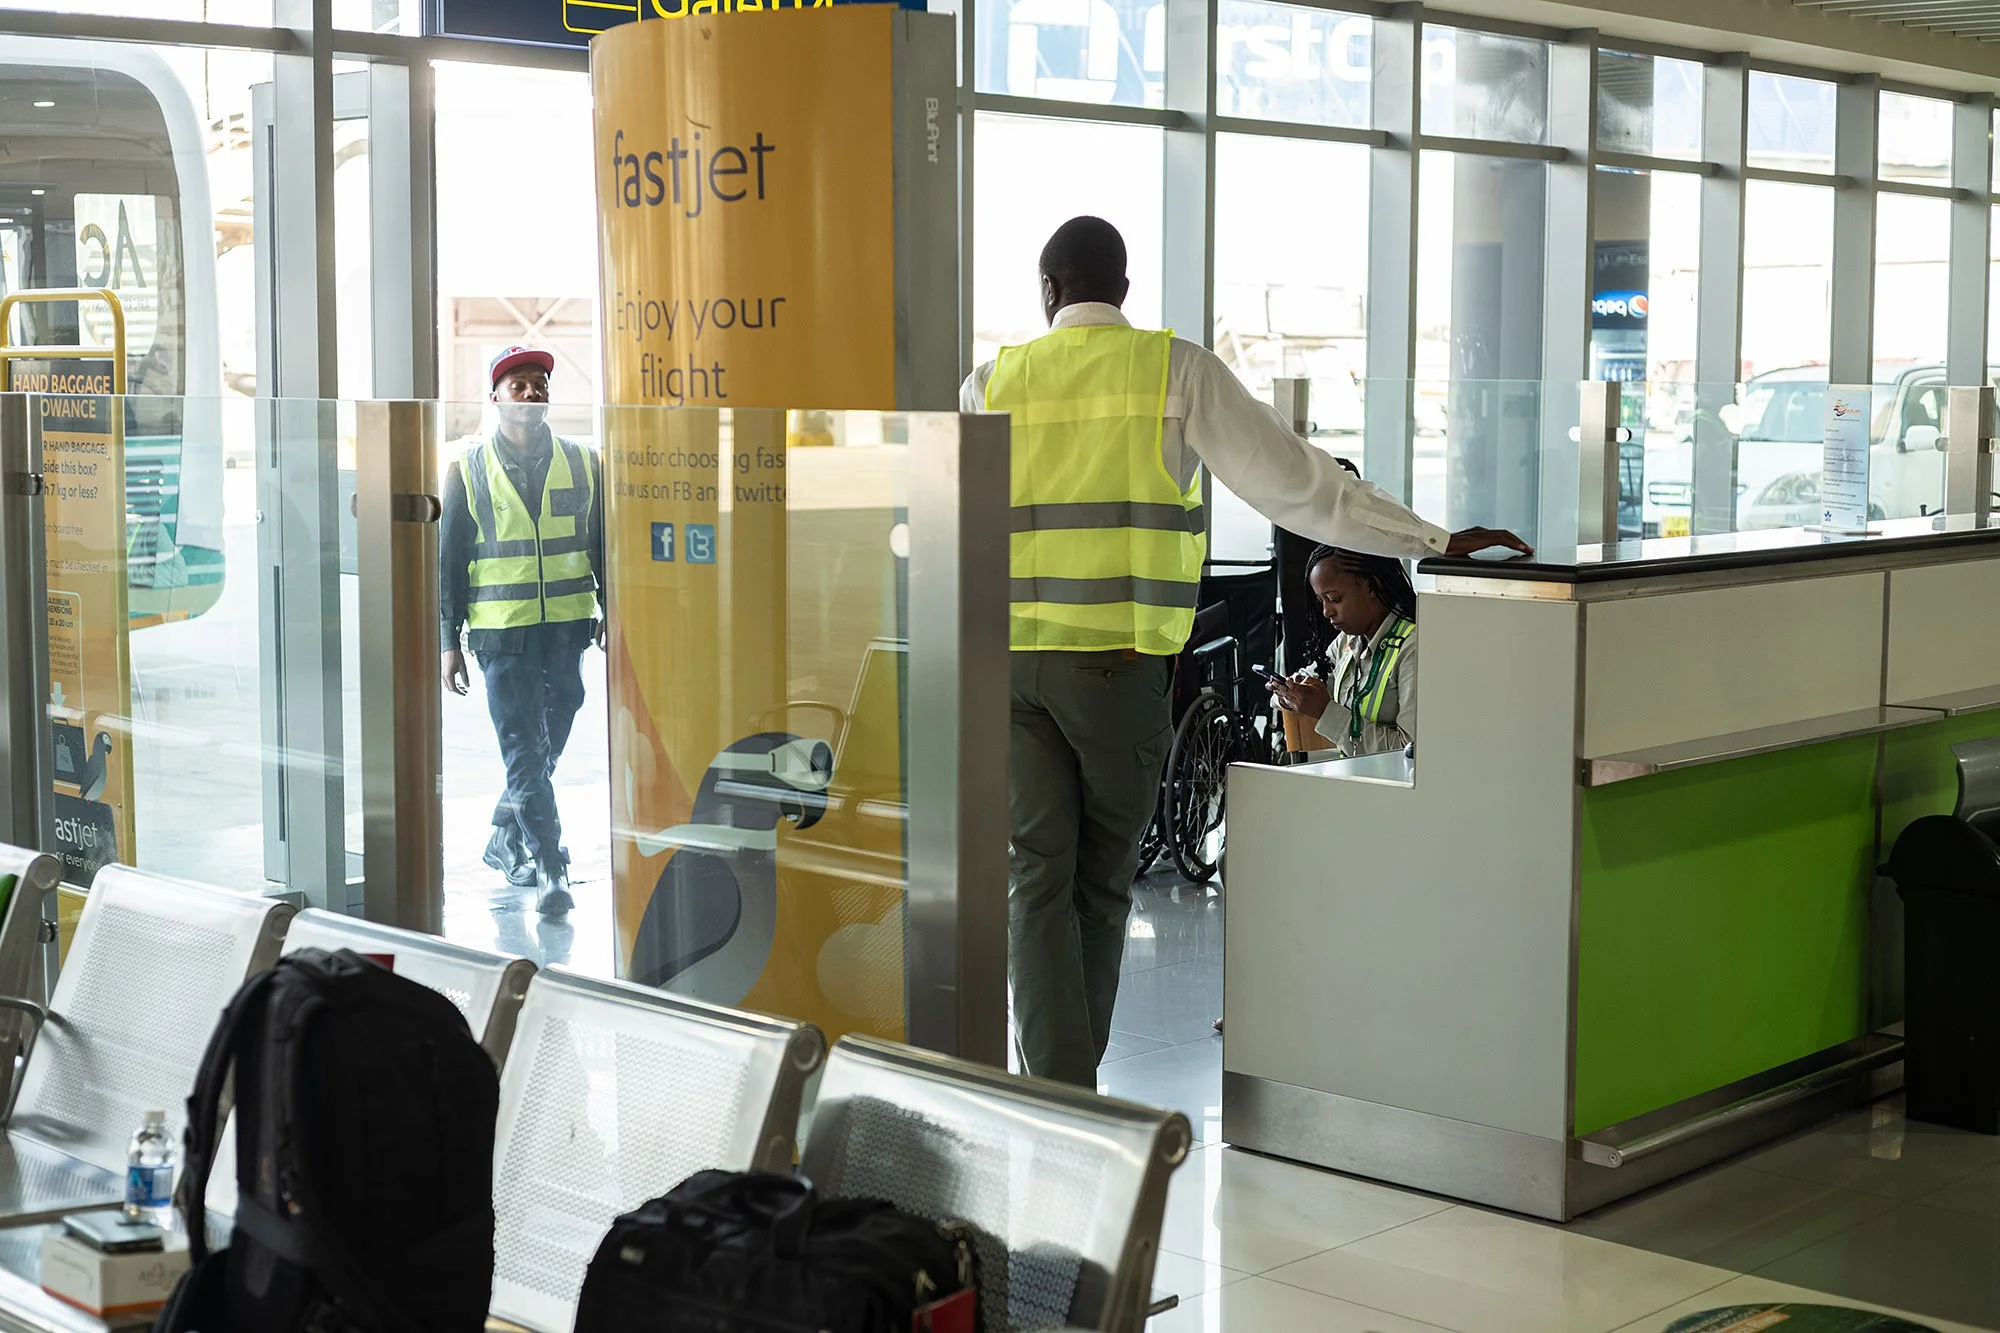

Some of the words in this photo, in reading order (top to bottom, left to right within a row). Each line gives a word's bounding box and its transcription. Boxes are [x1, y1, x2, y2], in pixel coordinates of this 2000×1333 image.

[613, 129, 776, 218] fastjet
[617, 290, 679, 342] Enjoy
[688, 297, 786, 341] your
[13, 374, 48, 392] HAND
[51, 374, 111, 394] BAGGAGE
[641, 352, 728, 409] flight
[41, 398, 96, 418] OWANCE
[49, 441, 69, 452] HAND
[71, 442, 107, 454] BAGGAGE:
[43, 459, 59, 473] side
[61, 460, 76, 475] this
[78, 461, 97, 475] box?
[627, 451, 643, 468] you
[646, 445, 664, 467] for
[668, 446, 750, 474] choosg
[51, 483, 55, 497] 7
[57, 482, 67, 500] kg
[69, 486, 77, 498] or
[79, 484, 98, 499] less?
[636, 483, 649, 499] us
[651, 484, 669, 500] on
[673, 480, 692, 501] FB
[696, 484, 720, 502] an
[48, 597, 70, 606] AXIMUM
[48, 606, 73, 615] ENSIONS
[55, 817, 98, 851] astjet
[55, 851, 64, 862] or
